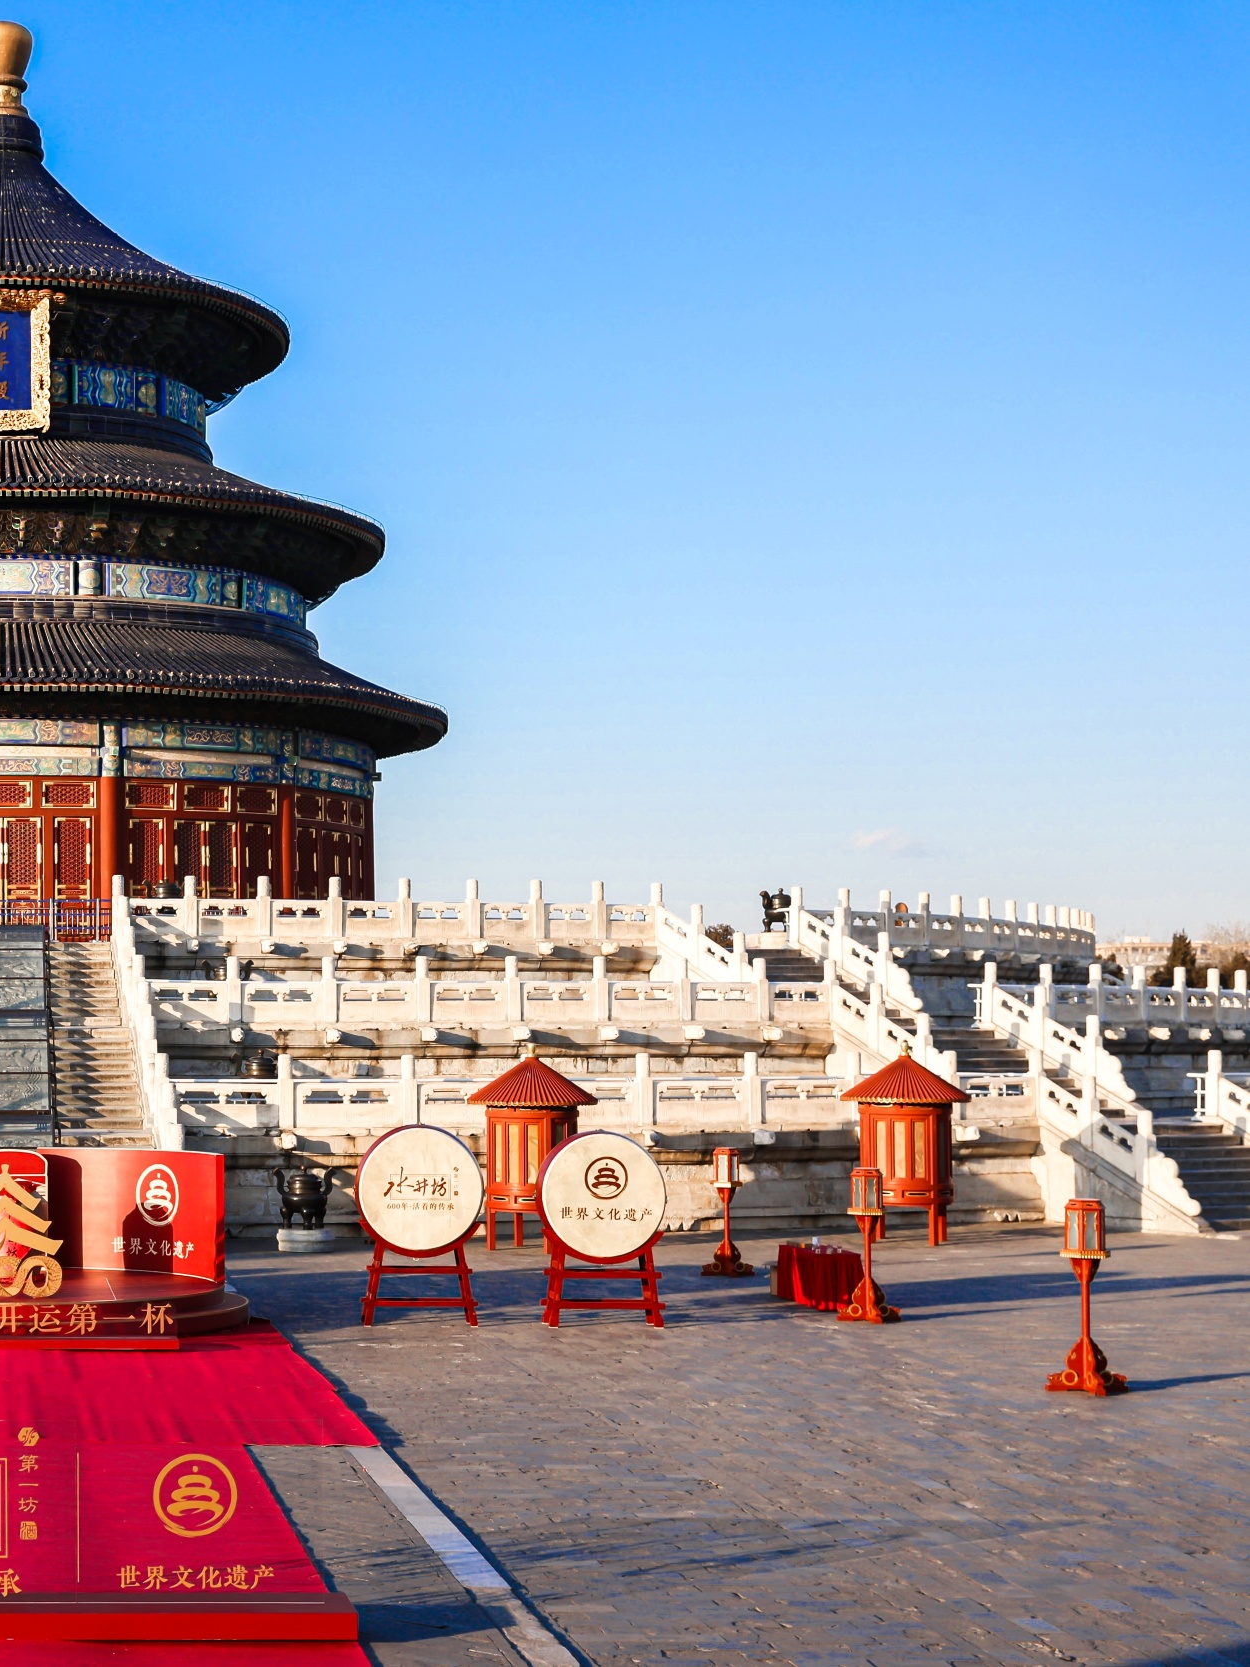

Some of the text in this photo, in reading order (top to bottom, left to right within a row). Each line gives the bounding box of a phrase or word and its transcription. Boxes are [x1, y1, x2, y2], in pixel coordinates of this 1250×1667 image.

[383, 1166, 447, 1197] 水井坊
[559, 1206, 653, 1222] 世界文化遗产
[110, 1236, 195, 1259] 世界文化遗产
[116, 1564, 276, 1591] 世界文化遗产
